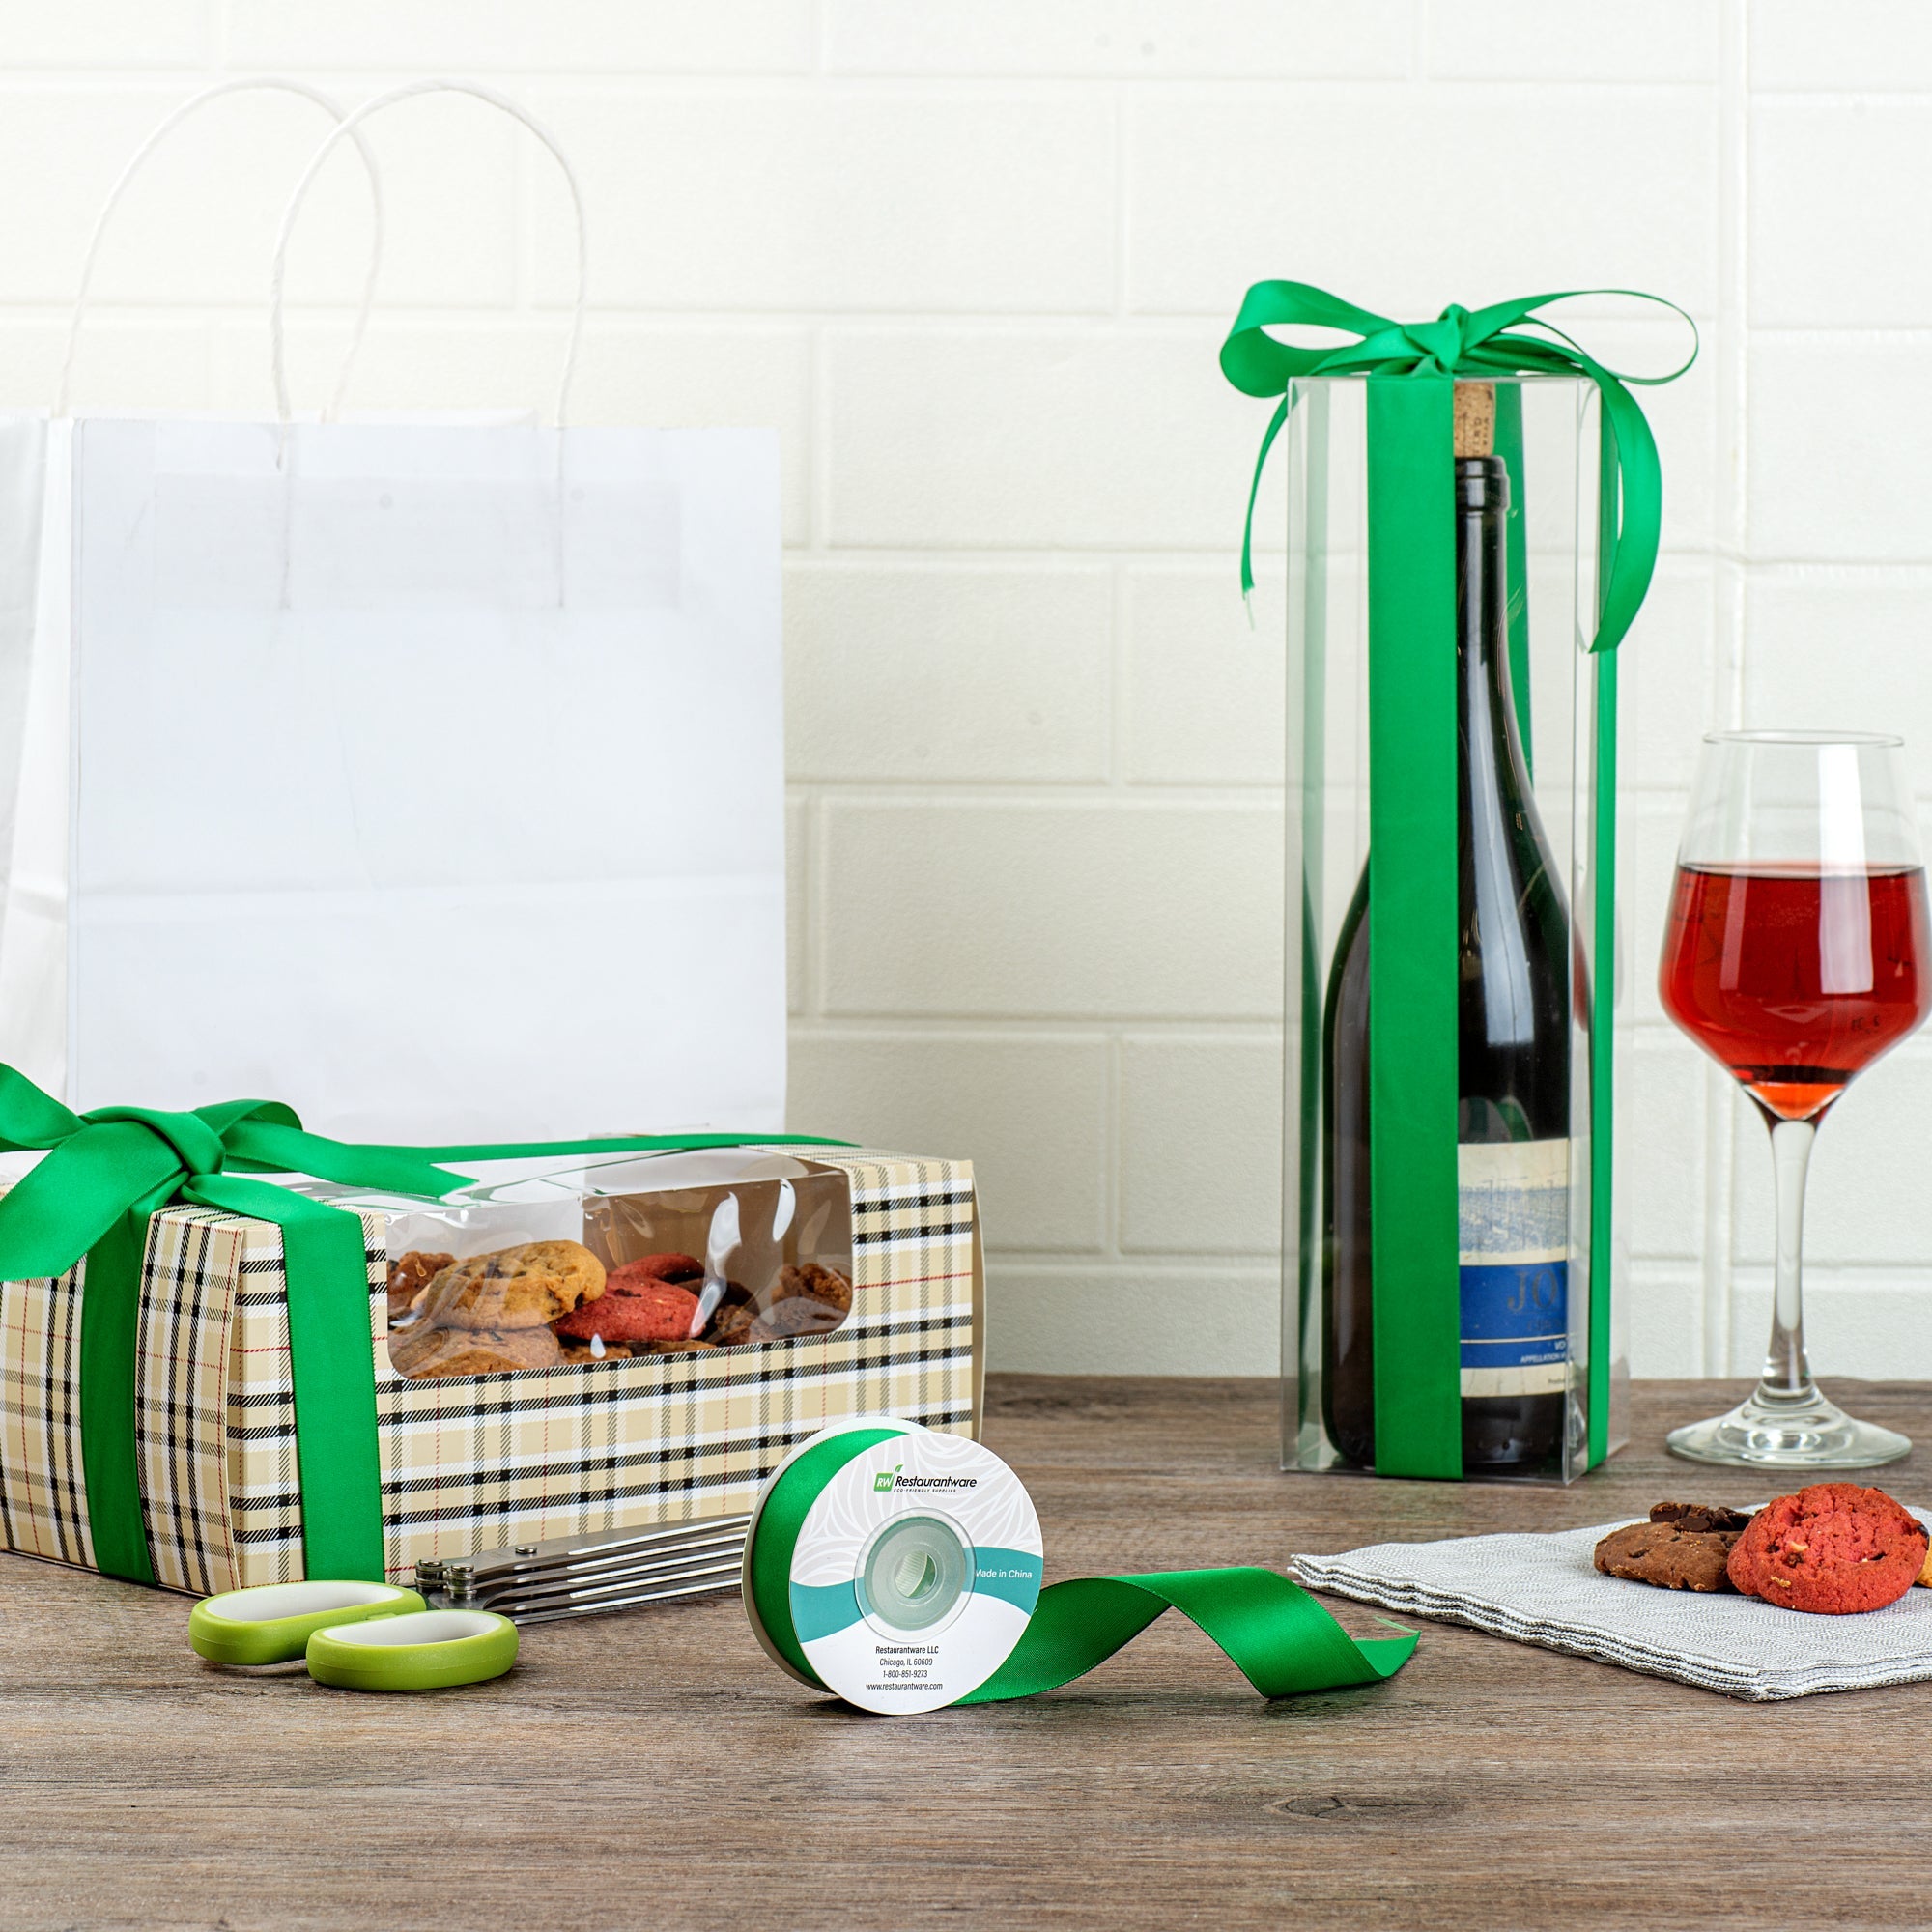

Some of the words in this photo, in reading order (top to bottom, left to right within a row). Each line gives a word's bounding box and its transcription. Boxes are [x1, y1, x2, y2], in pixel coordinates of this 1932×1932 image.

[876, 1477, 893, 1488] RW
[895, 1475, 978, 1488] Restaurantware
[976, 1568, 997, 1577] Made
[999, 1569, 1007, 1577] in
[1009, 1569, 1033, 1578] China
[875, 1645, 926, 1654] Restaurantware
[927, 1645, 939, 1654] LLC
[879, 1658, 905, 1667] Chicago,
[906, 1658, 912, 1666] IL
[914, 1658, 933, 1666] 60609
[866, 1682, 943, 1690] www.restaurantware.com
